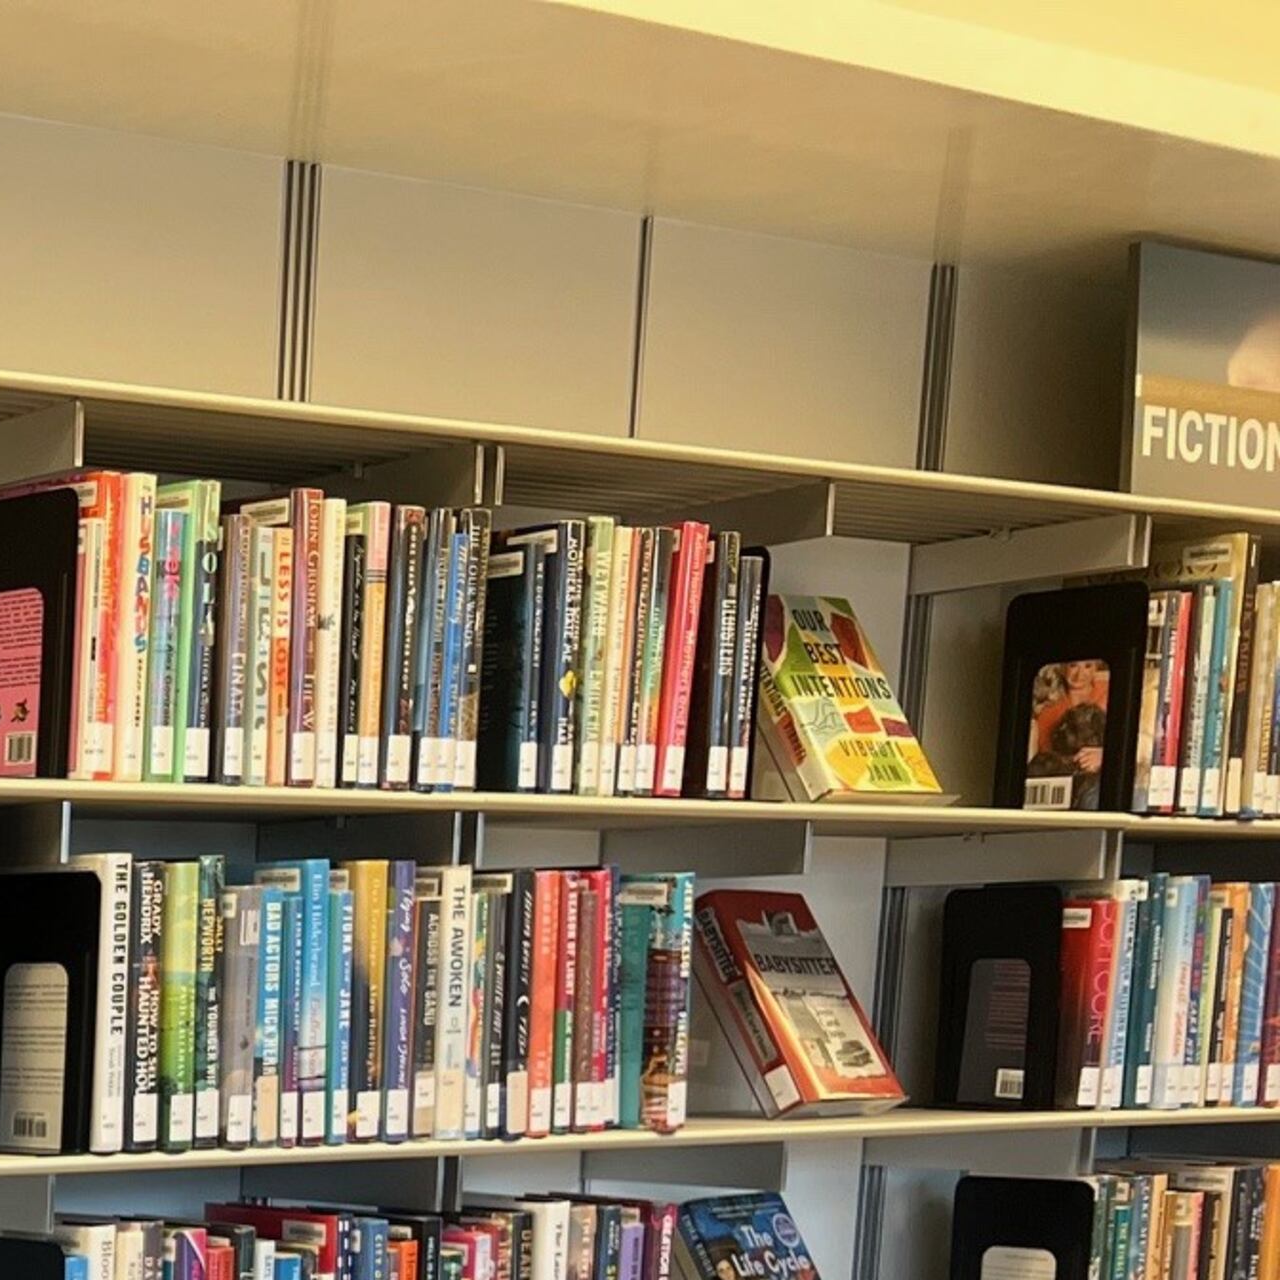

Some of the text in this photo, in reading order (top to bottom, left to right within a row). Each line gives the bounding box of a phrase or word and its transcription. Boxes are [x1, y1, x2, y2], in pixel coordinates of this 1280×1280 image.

[1141, 403, 1280, 472] FICTION
[791, 609, 830, 633] OUR
[804, 642, 847, 666] BEST
[791, 675, 892, 700] INTENTIONS
[110, 862, 128, 1036] THE GOLDEN COUPLE
[447, 885, 466, 1008] THE AWOKEN
[756, 955, 839, 976] BABYSITTER
[740, 1225, 774, 1248] The
[731, 1251, 811, 1277] Life Cycle
